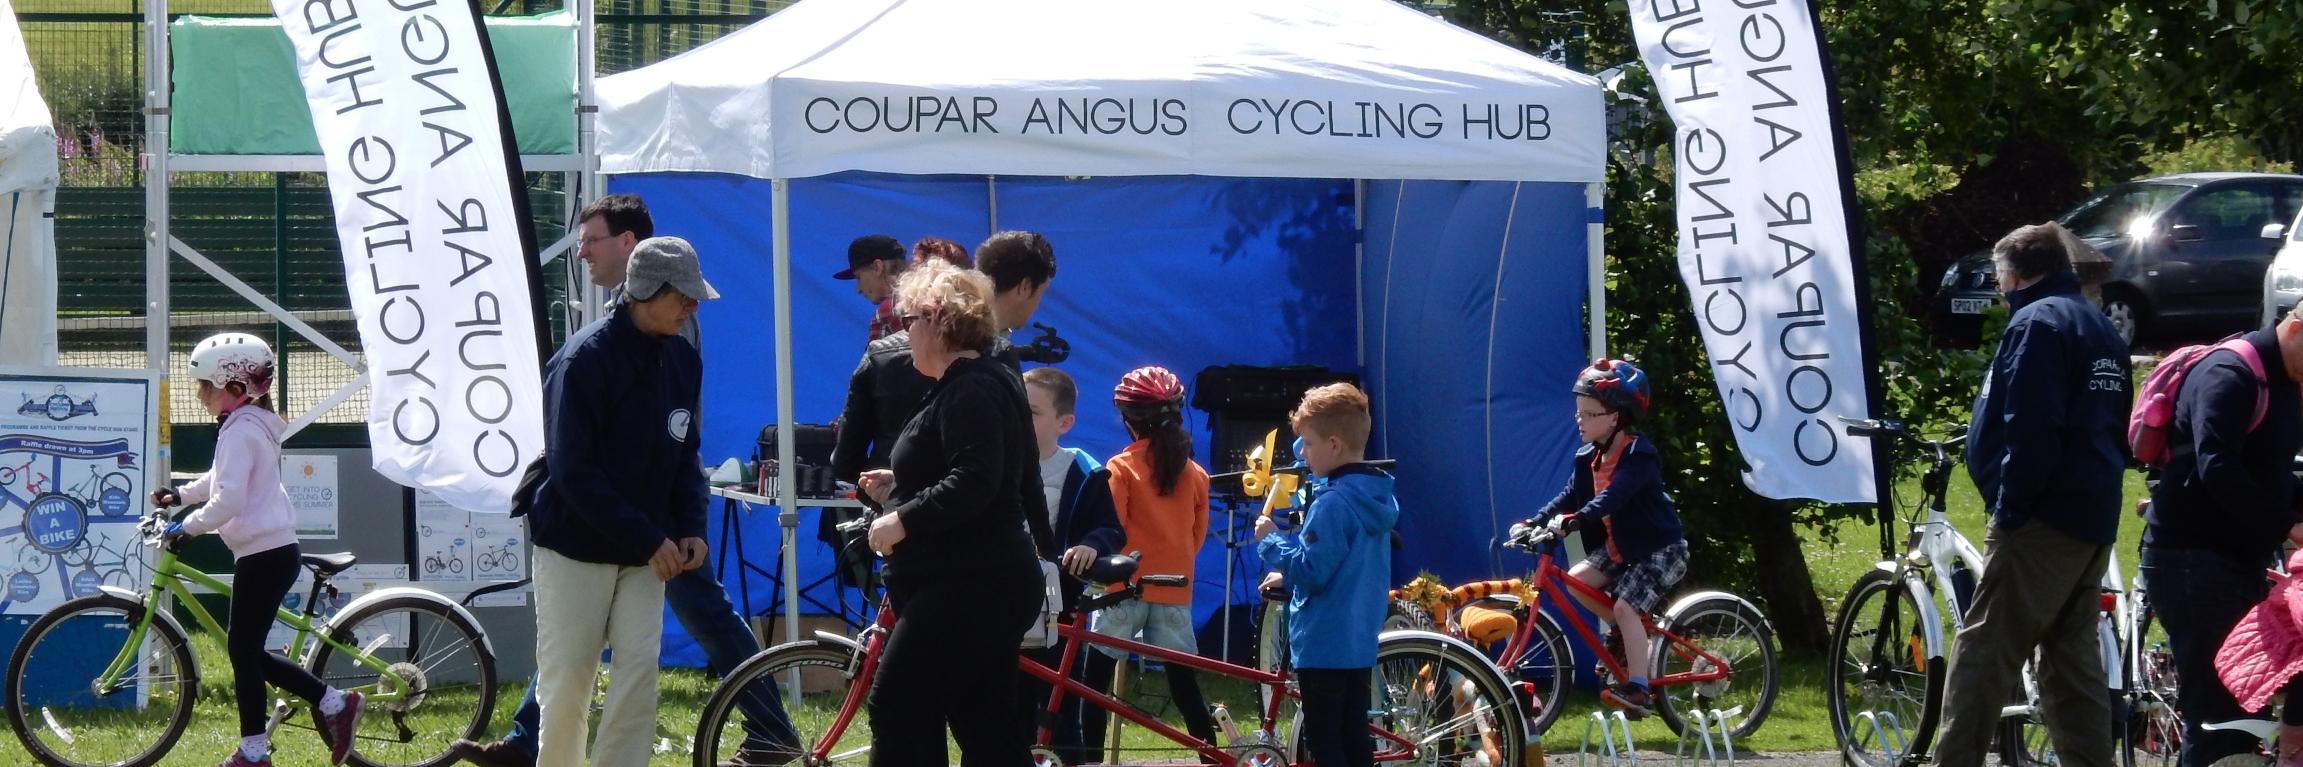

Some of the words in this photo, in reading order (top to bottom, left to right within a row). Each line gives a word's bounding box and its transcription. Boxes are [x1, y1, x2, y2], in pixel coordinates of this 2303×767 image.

[804, 95, 1000, 135] COUPAR
[1021, 97, 1188, 137] ANGUS
[1227, 98, 1444, 140] CYCLING
[1462, 103, 1552, 142] HUB
[20, 440, 43, 448] Raffle
[44, 443, 67, 451] drawn
[78, 446, 94, 454] 3pm
[36, 501, 67, 515] WIN
[50, 518, 60, 528] A
[40, 529, 75, 545] BIKE
